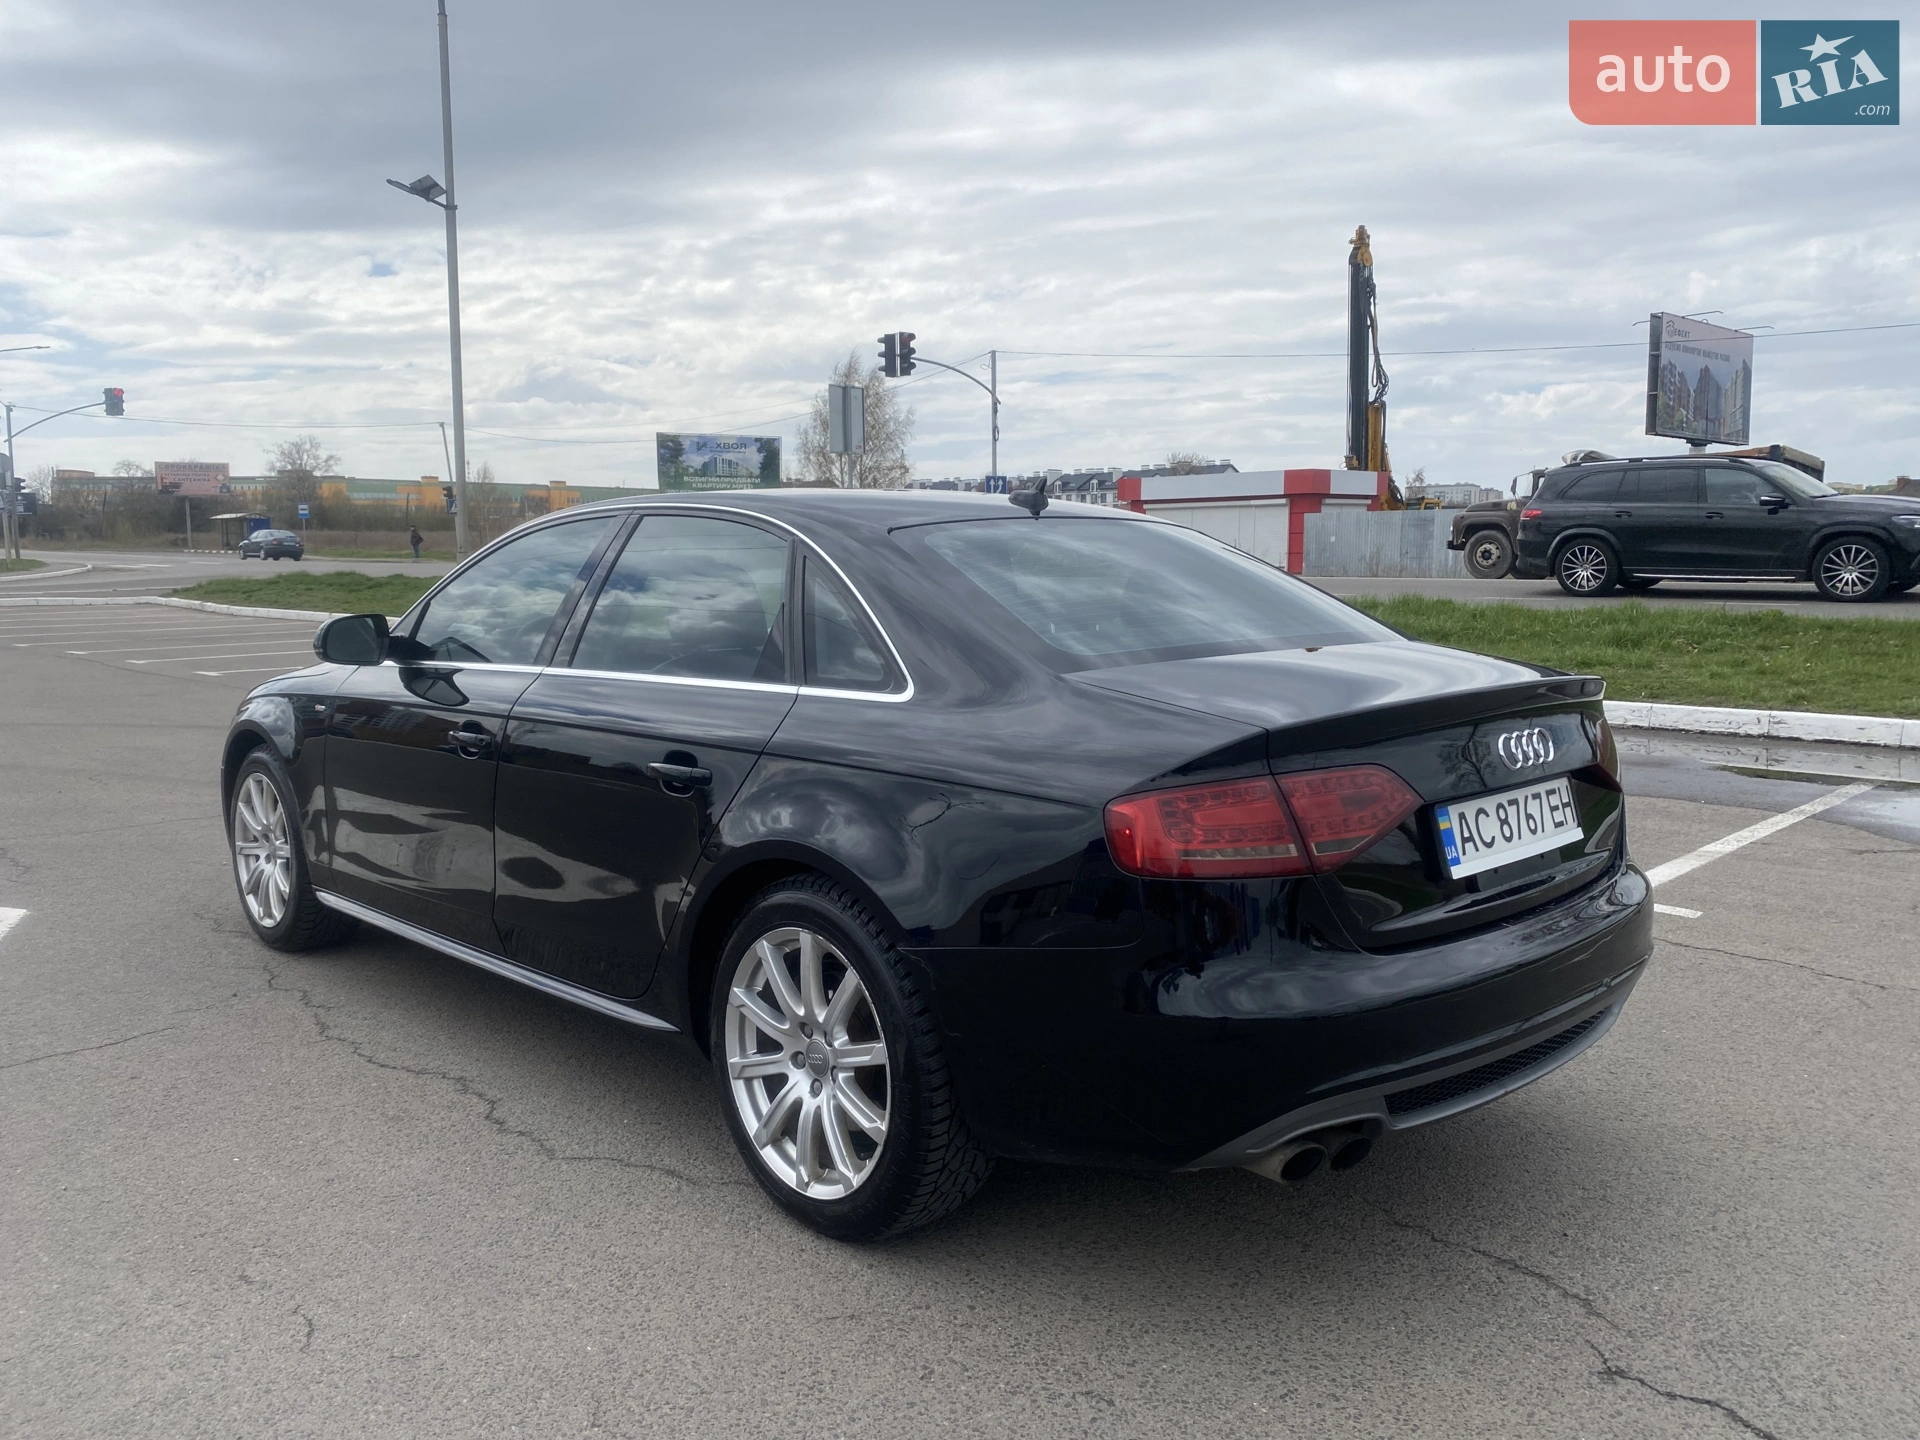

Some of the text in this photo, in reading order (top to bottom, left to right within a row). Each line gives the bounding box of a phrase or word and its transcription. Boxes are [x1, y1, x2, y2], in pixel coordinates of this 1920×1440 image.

[1458, 784, 1575, 856] AC 8767 EH
[1445, 846, 1458, 860] UA
